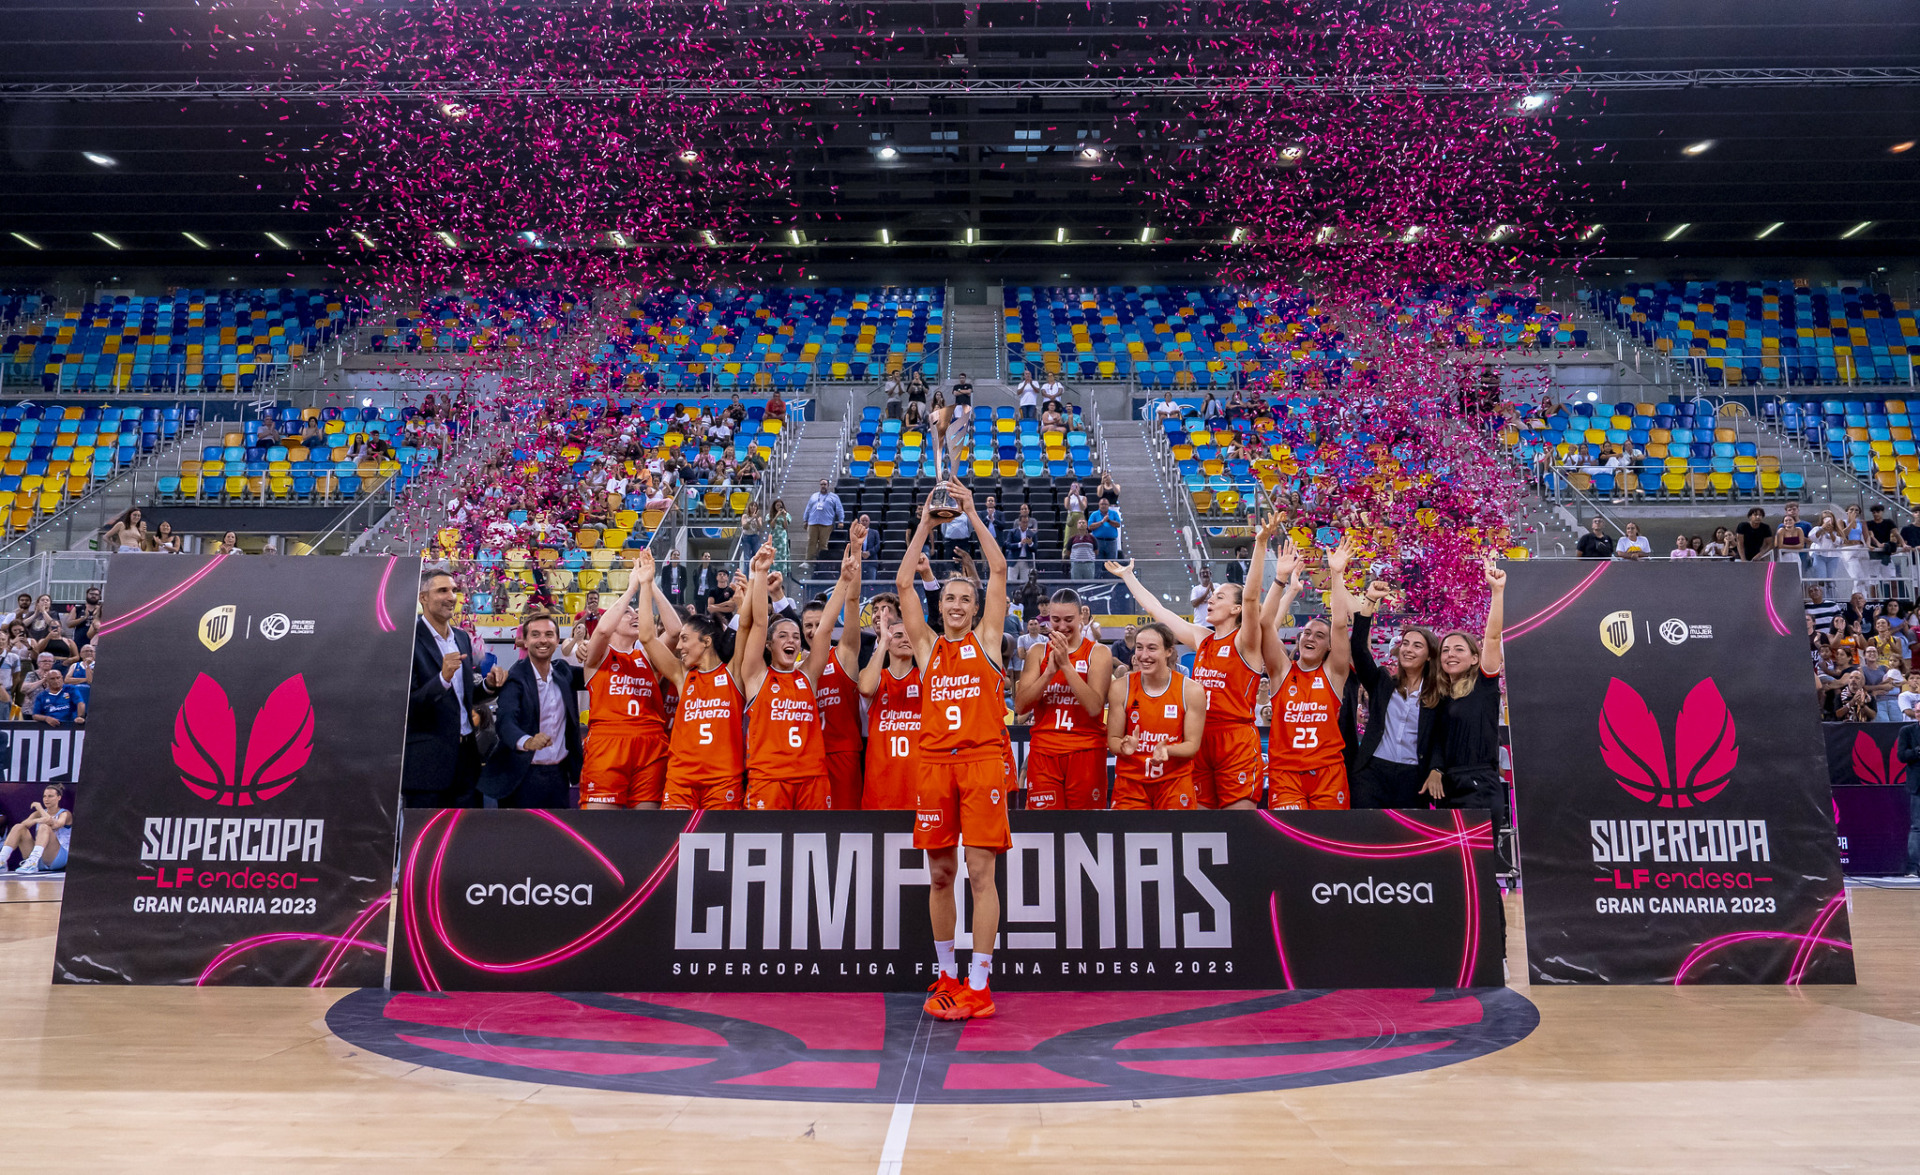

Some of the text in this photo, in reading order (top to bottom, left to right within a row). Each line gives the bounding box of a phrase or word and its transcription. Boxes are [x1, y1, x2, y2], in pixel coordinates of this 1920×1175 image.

[206, 615, 228, 643] 100
[1606, 620, 1628, 648] 100
[610, 674, 646, 686] Cultura
[930, 675, 980, 688] Cultura del
[609, 684, 652, 698] Esfuerzo
[930, 686, 981, 702] Esfuerzo
[627, 699, 640, 717] 0
[684, 697, 721, 711] Cultura
[770, 698, 808, 710] Cultura
[684, 708, 731, 722] Esfuerzo
[770, 709, 814, 722] Esfuerzo
[880, 709, 913, 721] Cultura
[945, 705, 962, 731] 9
[1054, 708, 1074, 731] 14
[1283, 711, 1328, 723] Esfuerzo
[699, 723, 713, 745] 5
[879, 719, 922, 732] Esfuerzo
[788, 726, 802, 748] 6
[1133, 730, 1169, 742] ultura
[1292, 727, 1319, 749] 23
[890, 736, 910, 757] 10
[1029, 794, 1054, 802] PULEVA
[140, 817, 325, 862] SUPERCOPA
[1589, 819, 1771, 862] SUPERCOPA
[156, 866, 298, 890] LF endesa
[1613, 867, 1753, 890] LF endesa
[465, 876, 593, 906] endesa
[1311, 875, 1434, 905] endesa
[133, 896, 317, 915] GRAN CANARIA 2023
[1595, 897, 1777, 914] GRAN CANARIA 2023
[672, 962, 820, 975] SUPERCOPA
[840, 962, 895, 975] LIGA
[1061, 962, 1156, 974] ENDESA
[1174, 961, 1233, 974] 2023
